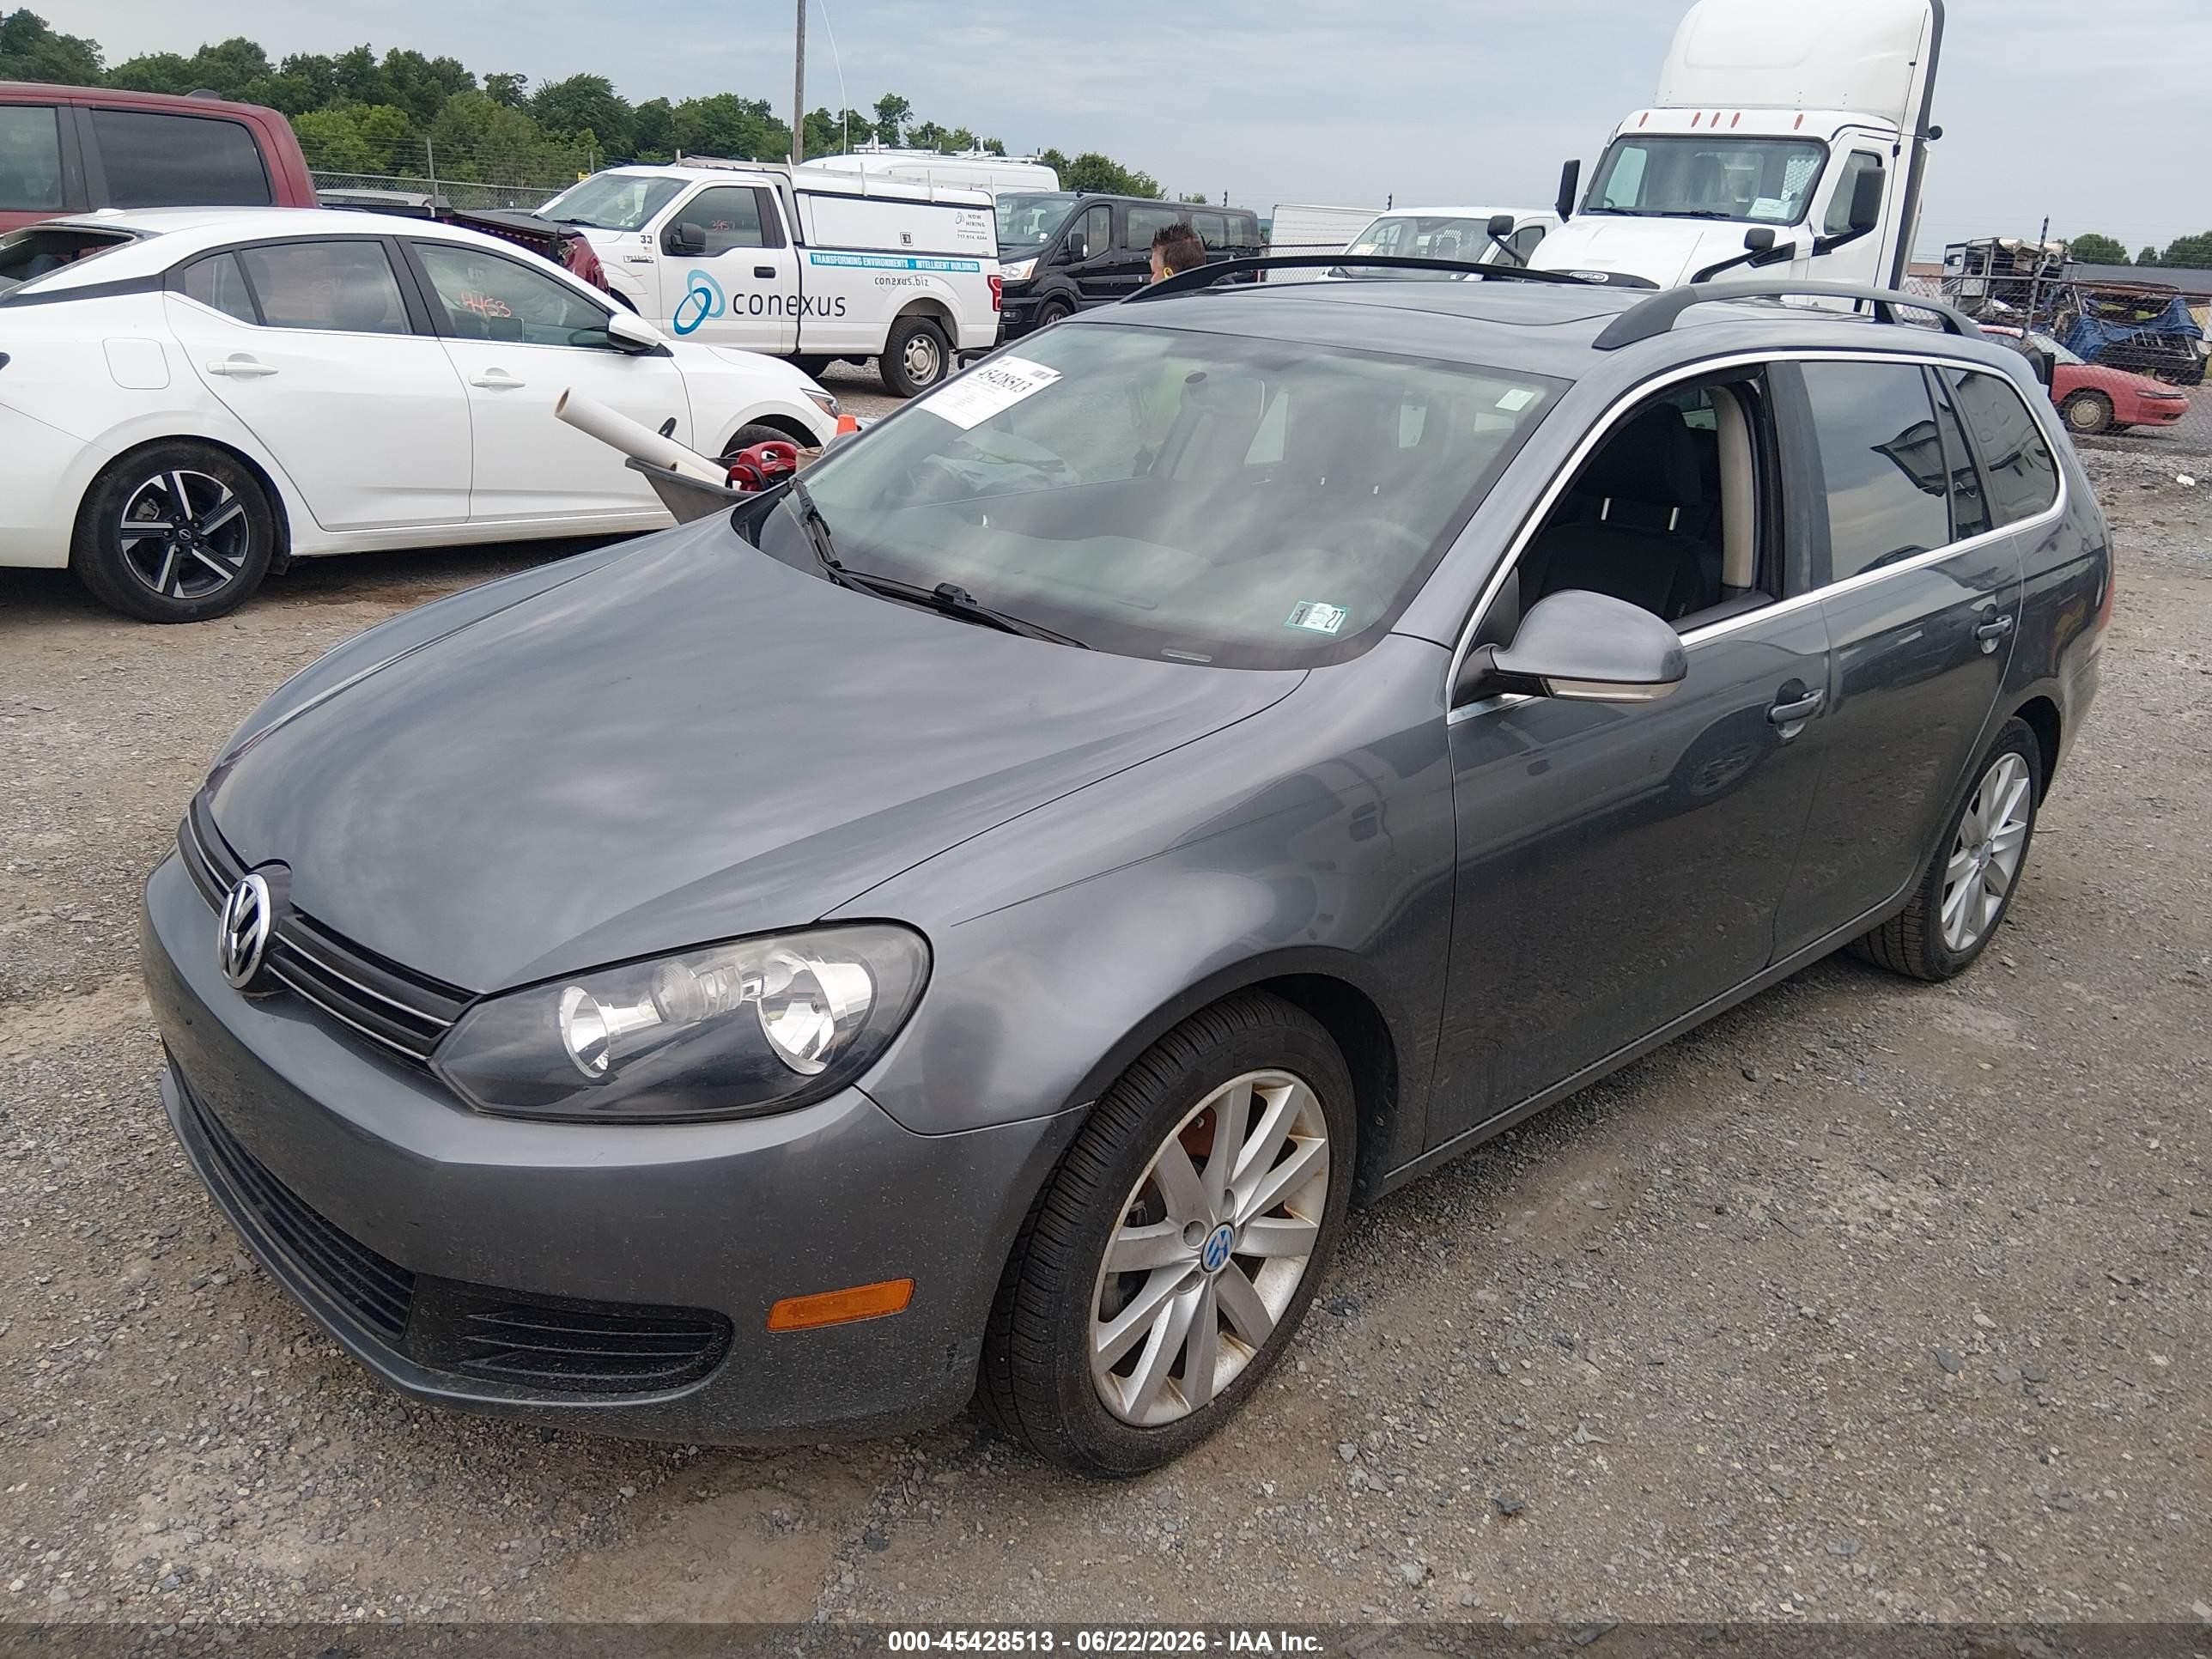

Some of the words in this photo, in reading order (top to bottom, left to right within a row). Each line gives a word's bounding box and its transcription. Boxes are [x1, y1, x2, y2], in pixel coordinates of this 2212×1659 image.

[640, 235, 653, 244] 33
[811, 254, 862, 265] TRANSFORMING
[863, 257, 908, 269] ENVIRONMENTS
[915, 259, 950, 270] INTELLIGENT
[951, 261, 978, 271] BUILDINGS
[874, 276, 929, 287] conexus.biz
[732, 292, 846, 317] conexus
